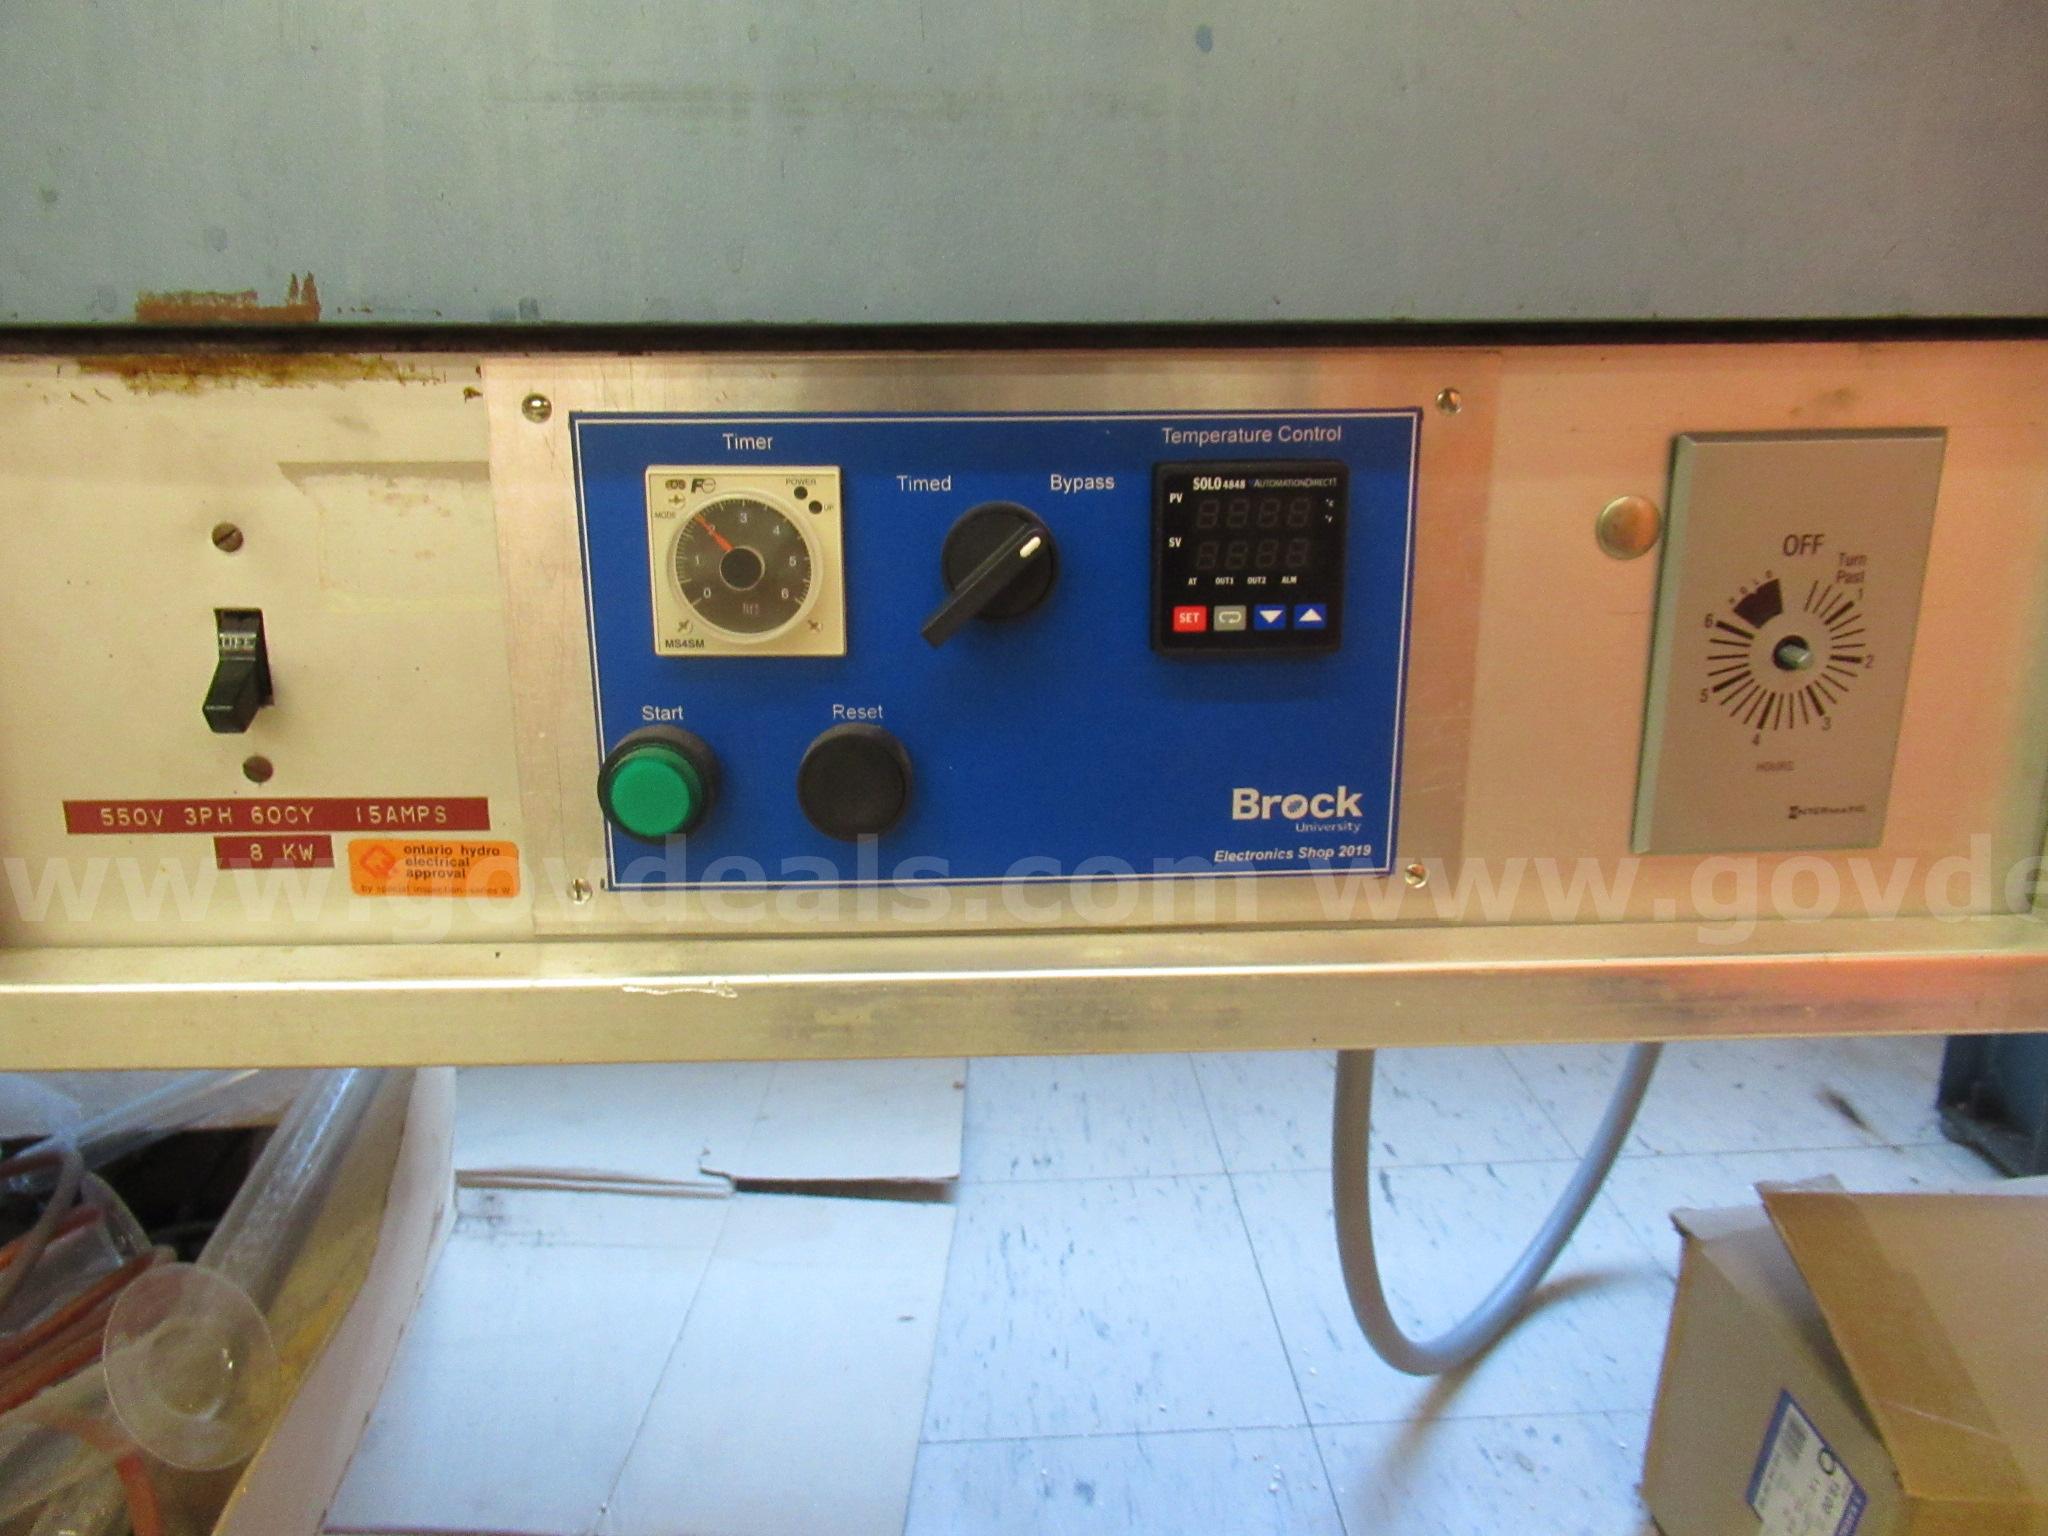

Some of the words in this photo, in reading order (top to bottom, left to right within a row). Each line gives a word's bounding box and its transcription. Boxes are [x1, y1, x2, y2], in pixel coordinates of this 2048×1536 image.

[722, 432, 774, 450] Timer
[1162, 427, 1273, 447] Temperature
[1277, 425, 1342, 443] Control
[785, 478, 817, 486] POWER
[896, 474, 952, 492] Timed
[1049, 473, 1116, 494] Bypass
[1192, 476, 1222, 491] SOLO
[1169, 492, 1184, 504] PV
[739, 512, 749, 525] 3
[772, 524, 782, 536] 4
[1168, 536, 1183, 548] SV
[1782, 533, 1825, 557] OFF
[788, 556, 798, 567] 5
[1187, 576, 1198, 586] AT
[1281, 575, 1298, 584] ALM
[702, 587, 712, 599] 0
[781, 588, 790, 600] 6
[1178, 612, 1200, 624] SET
[1704, 612, 1715, 629] 6
[664, 638, 706, 649] MS4SM
[1864, 653, 1875, 669] 2
[1699, 687, 1709, 704] 5
[642, 704, 685, 721] Start
[832, 703, 884, 720] Reset
[1821, 716, 1832, 731] 3
[1232, 785, 1364, 821] Brock
[99, 807, 164, 827] 550V
[183, 807, 233, 826] 3PH
[250, 805, 315, 825] 60CY
[1294, 821, 1362, 834] University
[249, 843, 263, 862] 8
[282, 842, 314, 862] KW
[403, 844, 453, 856] ontario
[460, 845, 501, 857] hydro
[1213, 847, 1294, 863] Electronics
[1297, 846, 1335, 861] Shop
[1338, 844, 1373, 858] 2019
[405, 855, 470, 868] electrical
[406, 867, 466, 880] approval
